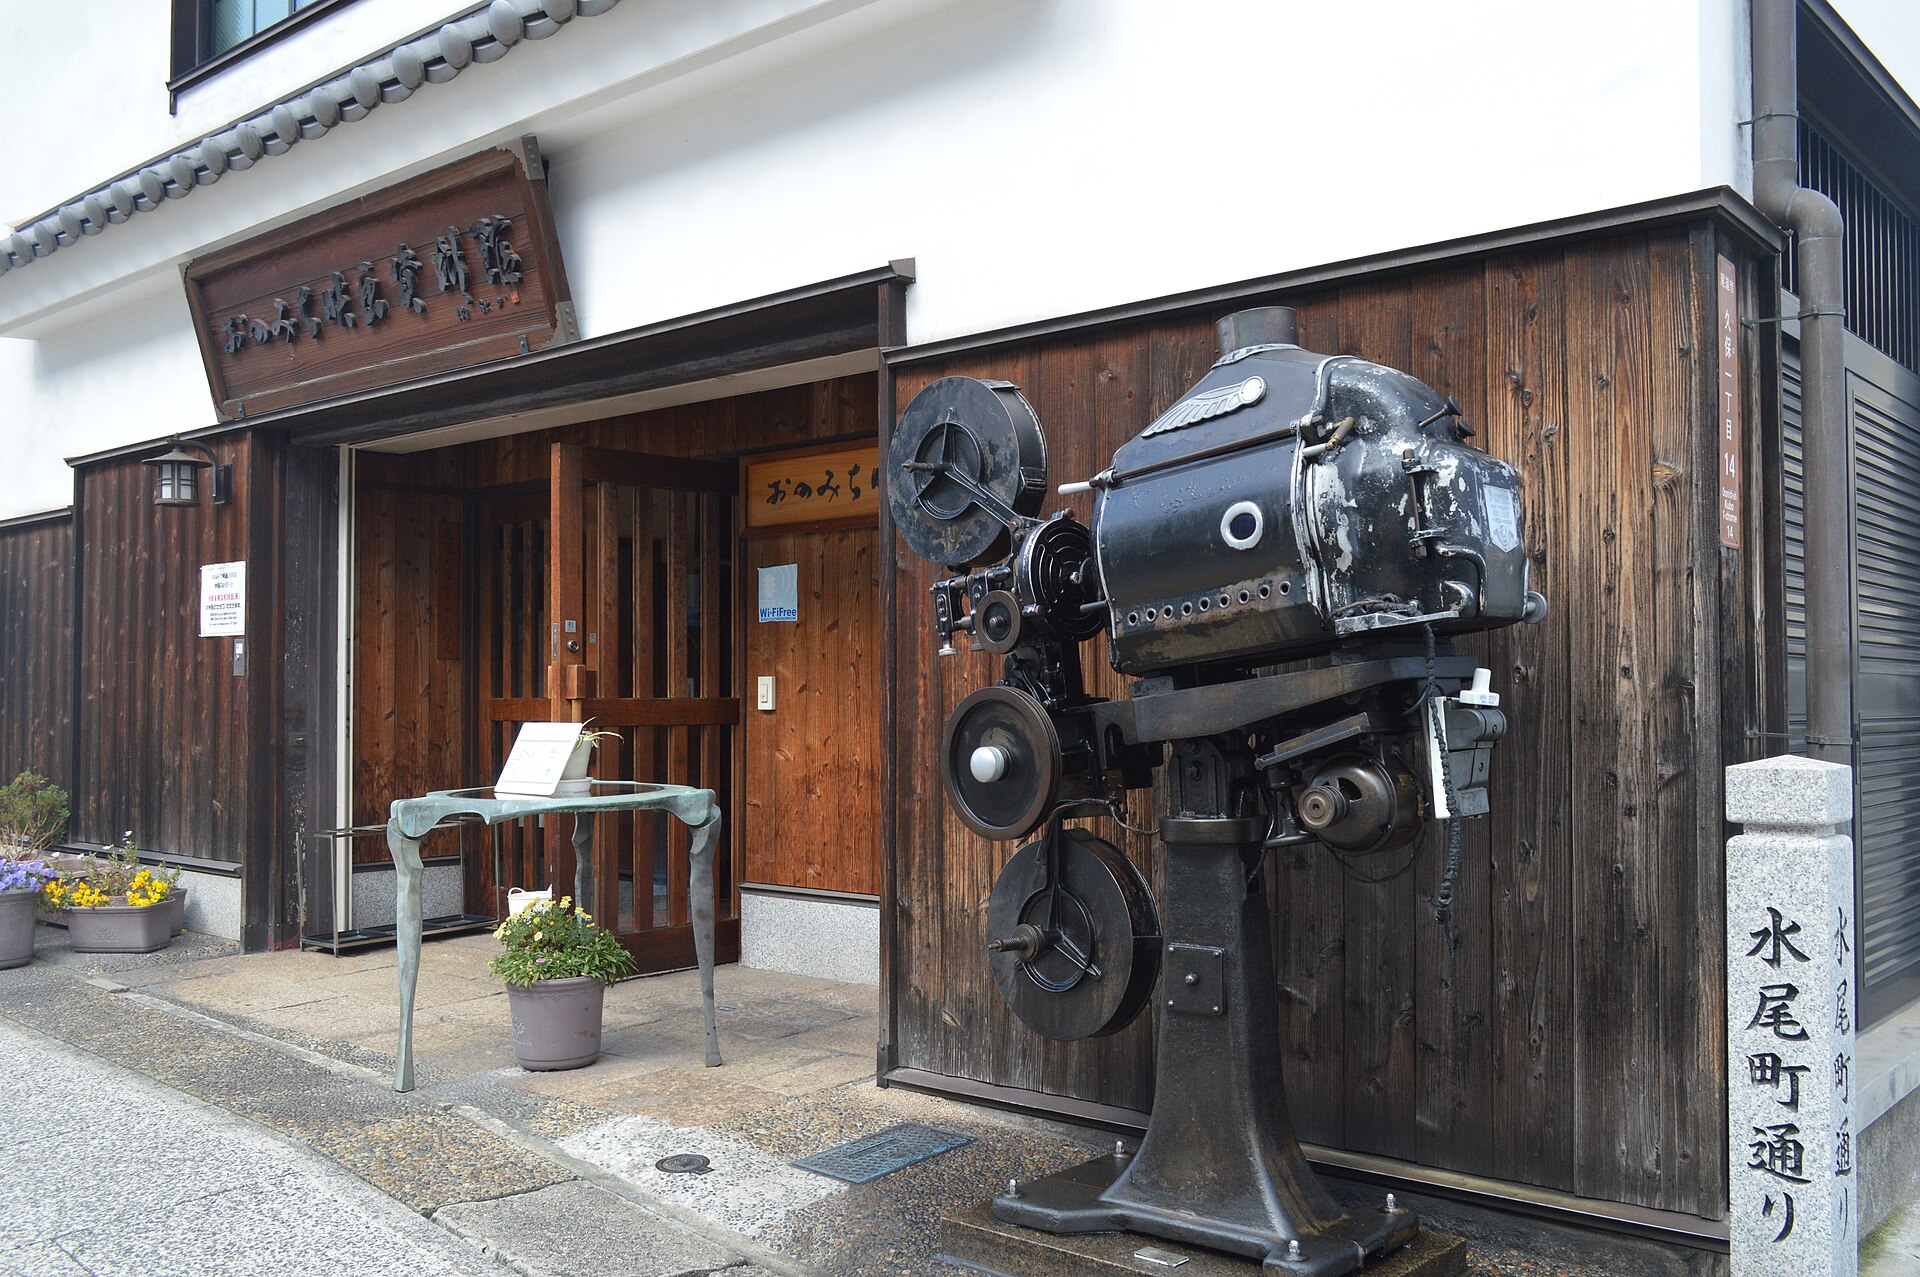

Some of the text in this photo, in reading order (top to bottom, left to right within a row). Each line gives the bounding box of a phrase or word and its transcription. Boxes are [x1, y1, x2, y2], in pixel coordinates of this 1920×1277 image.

[1724, 309, 1736, 478] 久保一丁目 14
[1726, 525, 1734, 539] 14
[1744, 905, 1812, 1243] 水尾町通り
[1833, 906, 1852, 1242] 水尾町通り
